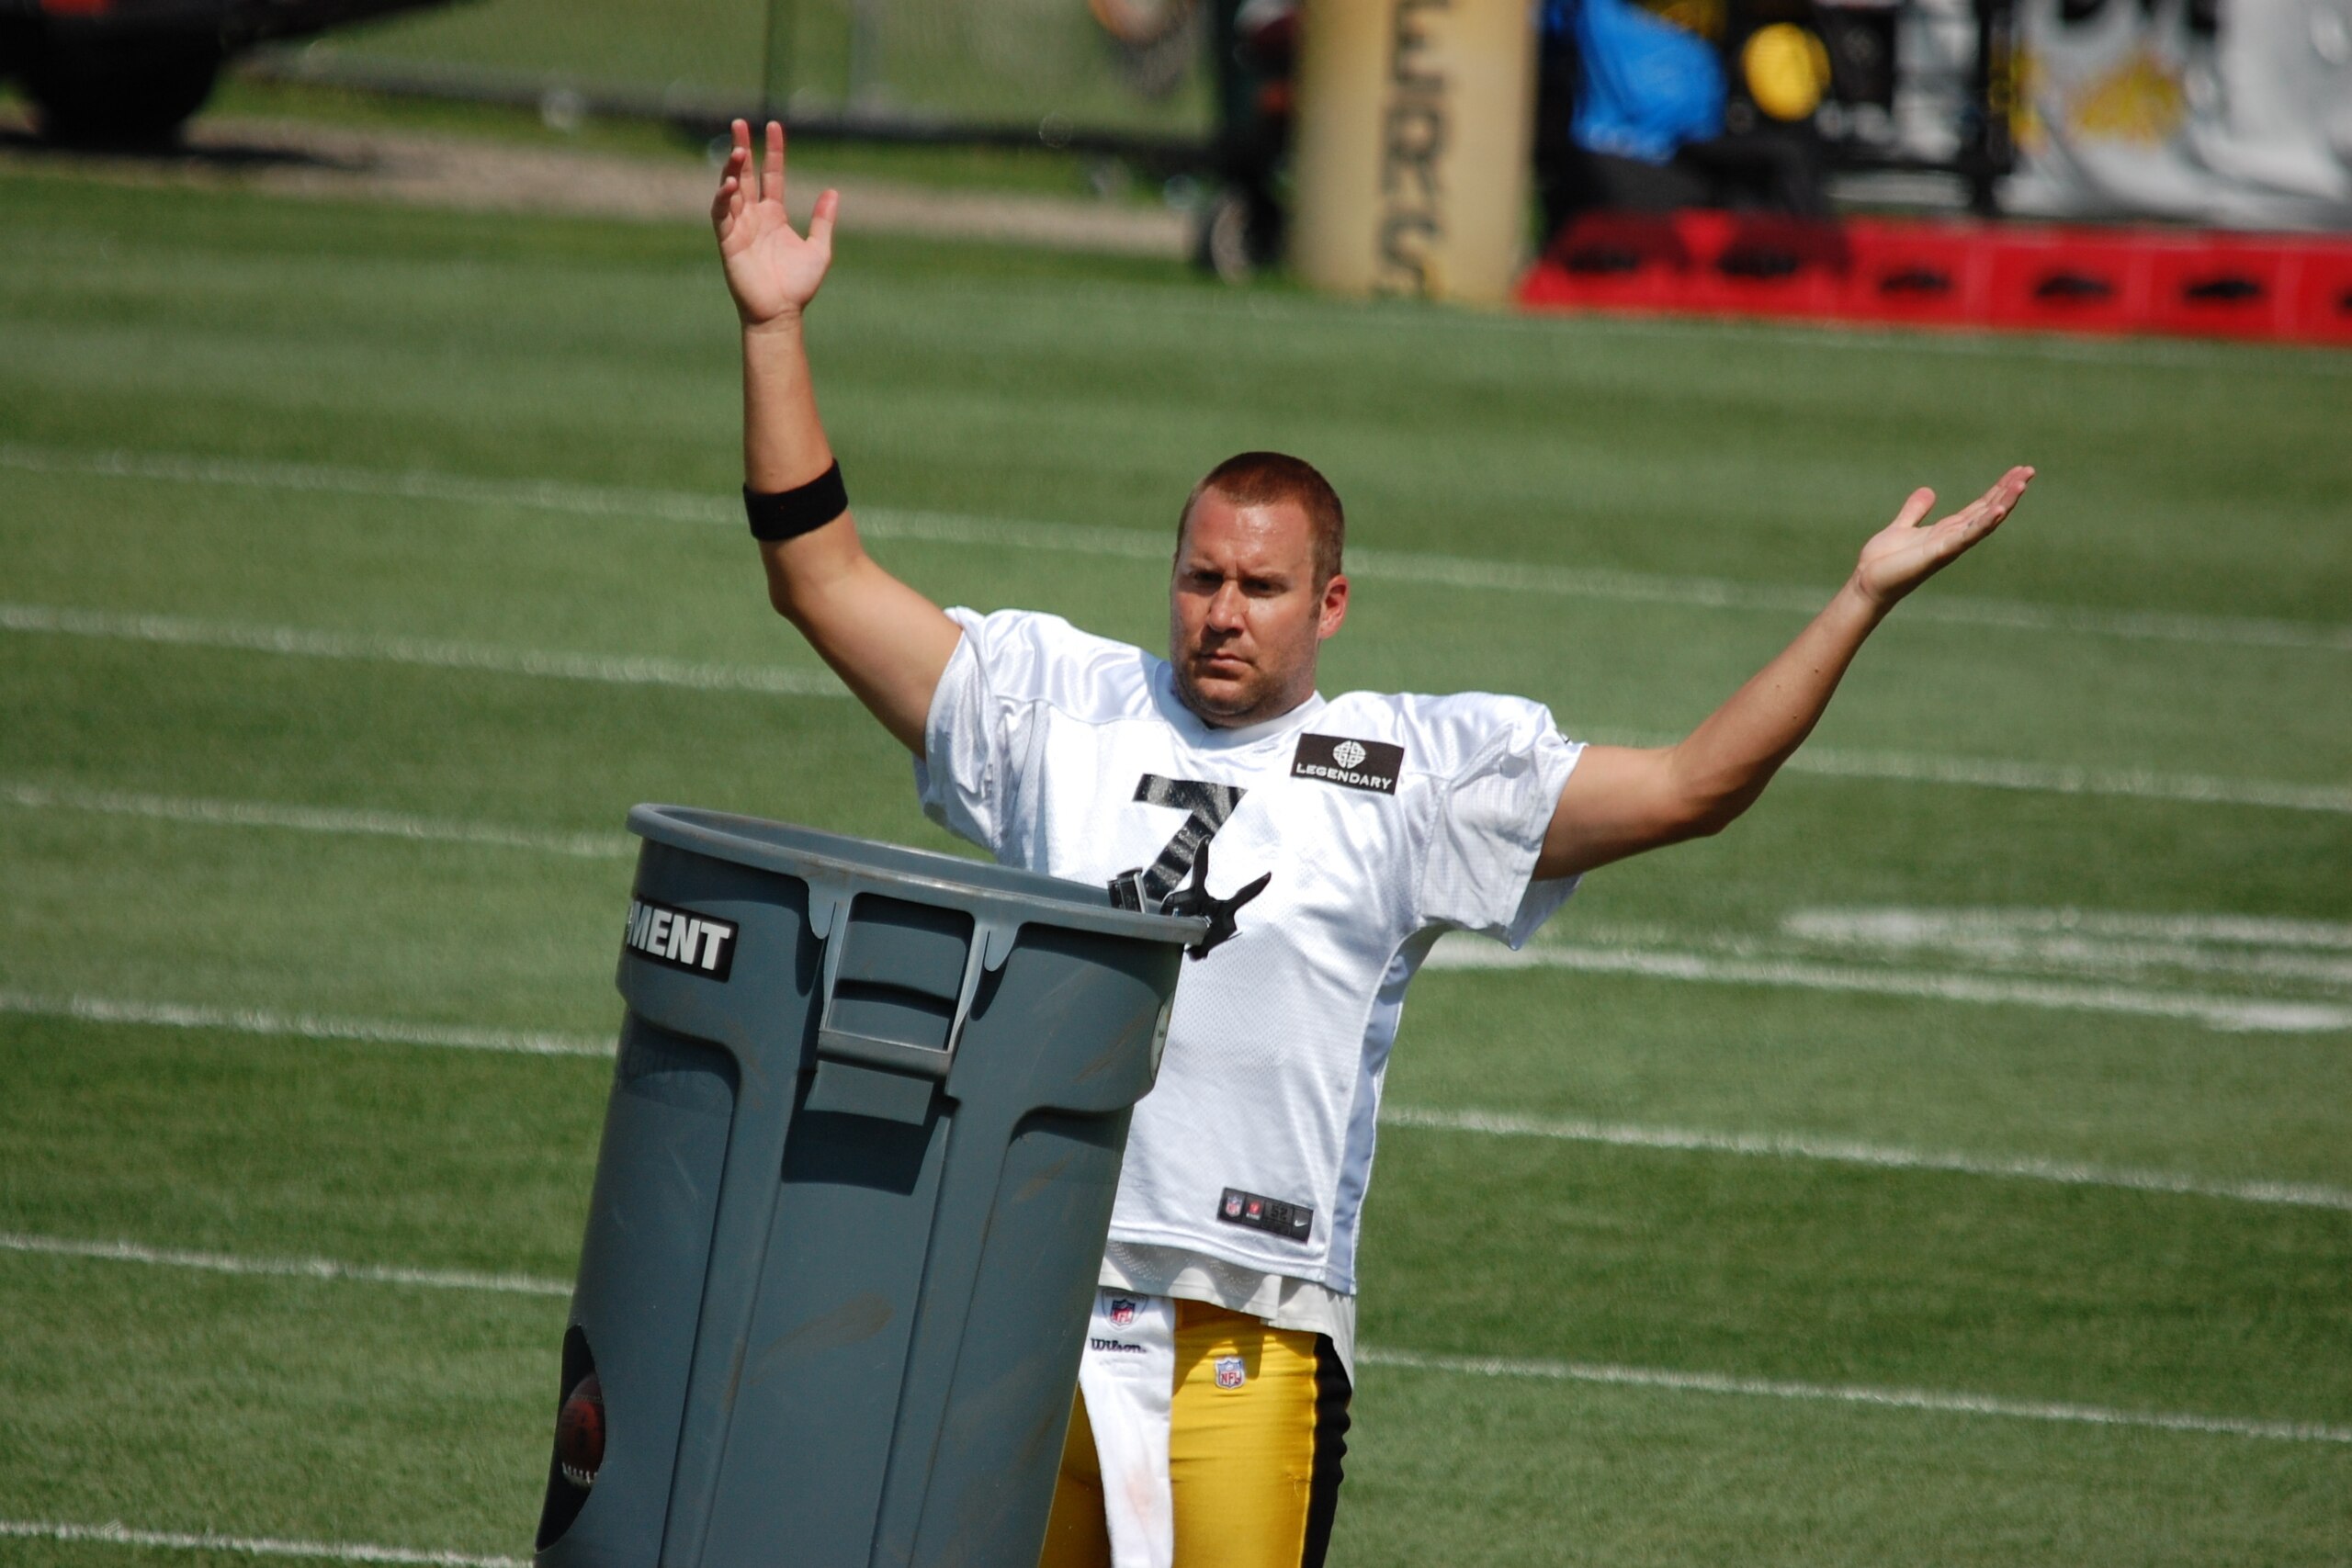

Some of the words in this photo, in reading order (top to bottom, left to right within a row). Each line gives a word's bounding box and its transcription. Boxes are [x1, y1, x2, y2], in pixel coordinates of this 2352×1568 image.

[1295, 762, 1393, 790] LEGENDARY
[1132, 773, 1249, 903] 7
[627, 900, 731, 971] MENT
[1091, 1337, 1143, 1353] Wilson
[1220, 1371, 1242, 1385] NFL
